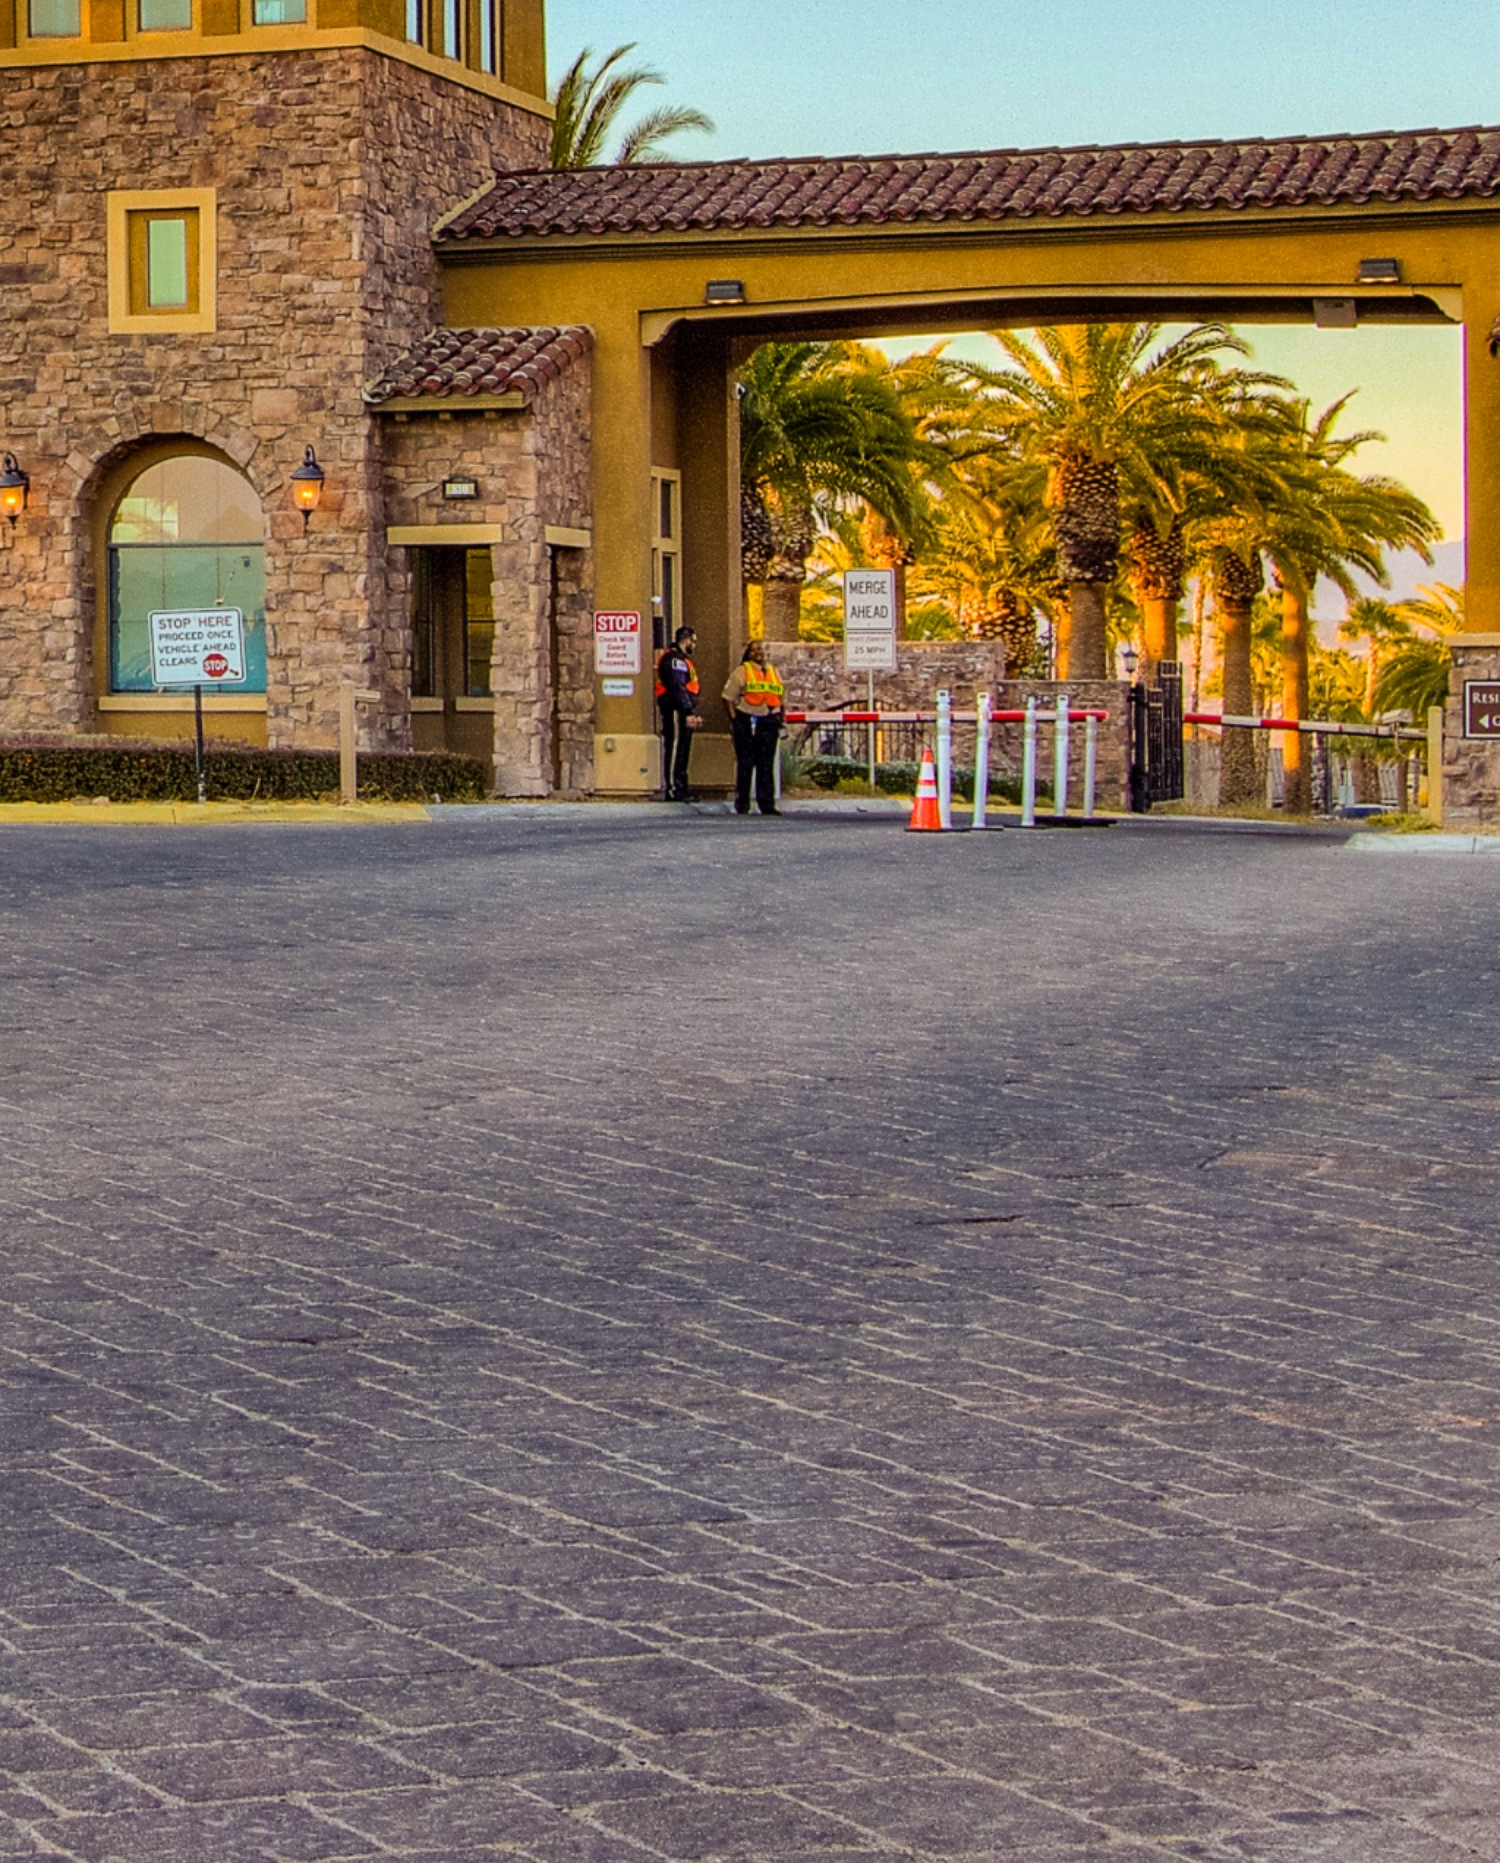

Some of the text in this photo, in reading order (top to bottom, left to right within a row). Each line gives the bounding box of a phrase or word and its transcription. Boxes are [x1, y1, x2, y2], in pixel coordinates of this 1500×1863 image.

[849, 581, 888, 594] MERGE
[850, 605, 889, 618] AHEAD
[158, 615, 232, 630] STOP HERE
[597, 615, 636, 631] STOP
[158, 630, 234, 641] PROCEED ONCE
[158, 642, 236, 654] VEHICLE AHEAD
[854, 645, 886, 654] 25 MPH
[159, 657, 227, 671] CLEARS STOP
